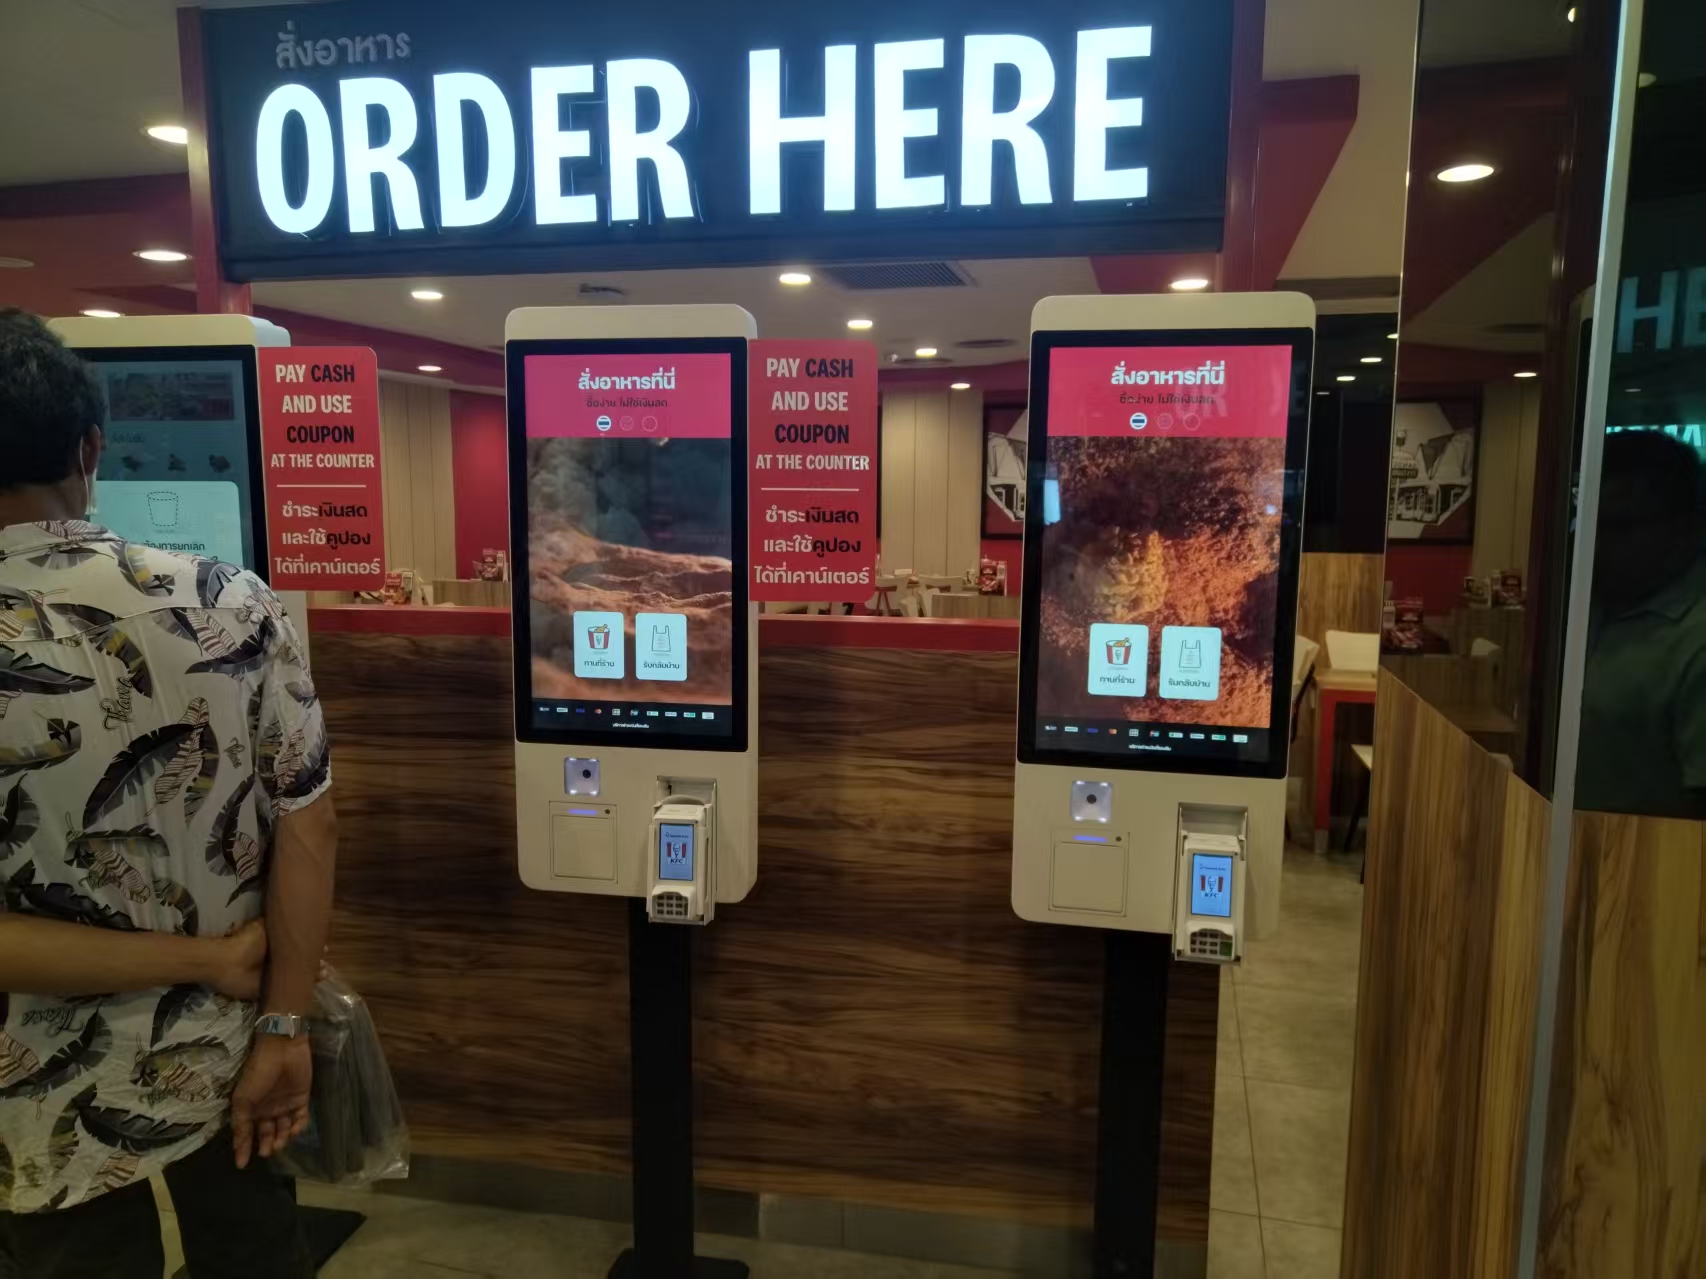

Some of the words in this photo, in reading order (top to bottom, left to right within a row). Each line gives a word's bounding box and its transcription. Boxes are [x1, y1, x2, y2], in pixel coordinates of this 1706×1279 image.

[275, 20, 412, 70] สั่งอาหาร
[256, 58, 695, 234] ORDER
[748, 25, 1153, 215] HERE
[275, 364, 306, 383] PAY
[310, 364, 355, 383] CASH
[766, 358, 800, 378] PAY
[805, 358, 854, 378] CASH
[1111, 360, 1225, 385] สั่งอาหารที่นี่
[578, 367, 676, 390] สั่งอาหารที่นี่
[282, 395, 317, 413] AND
[320, 395, 352, 413] USE
[771, 391, 810, 411] AND
[814, 391, 849, 411] USE
[286, 426, 355, 443] COUPON
[774, 424, 850, 444] COUPON
[270, 454, 286, 468] AT
[289, 454, 314, 468] THE
[316, 454, 375, 469] COUNTER
[755, 454, 773, 469] AT
[776, 454, 803, 470] THE
[805, 455, 870, 471] COUNTER
[282, 501, 368, 518] ชำระเงินสด
[765, 505, 860, 524] ชำระเงินสด
[282, 528, 372, 550] และใช้คูปอง
[764, 535, 862, 558] และใช้คูปอง
[274, 554, 381, 575] ได้ที่เคาน์เตอร์
[754, 561, 870, 585] ได้ที่เคาน์เตอร์
